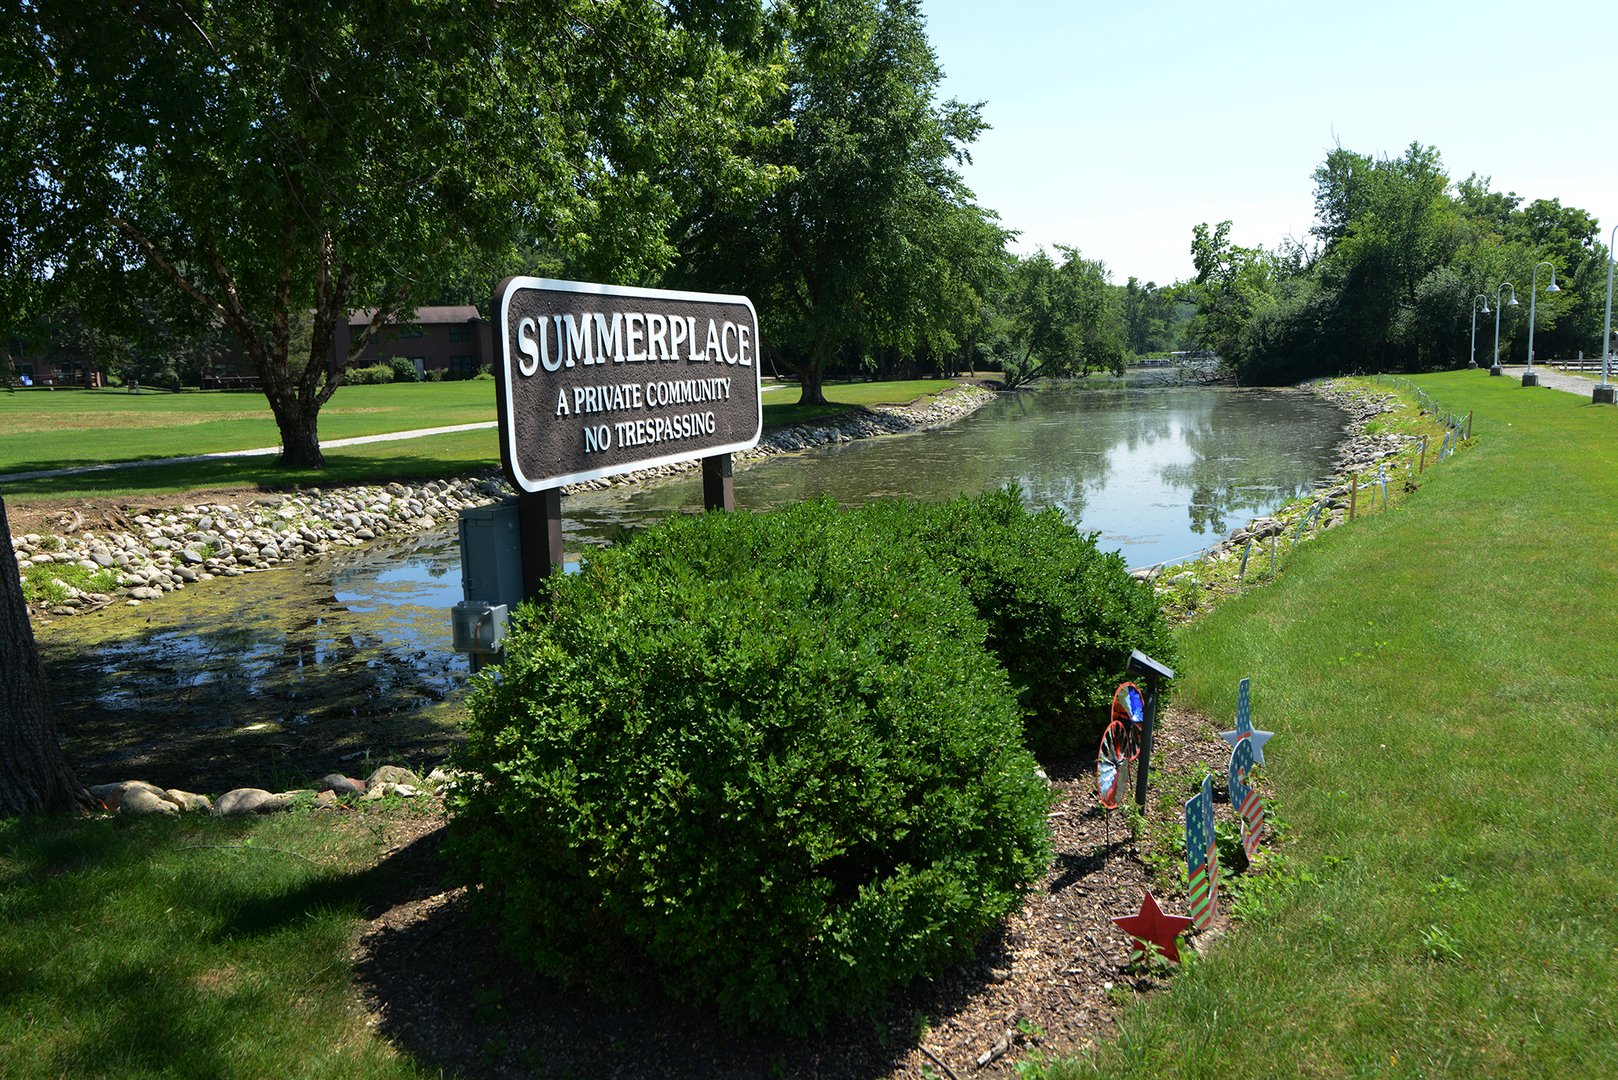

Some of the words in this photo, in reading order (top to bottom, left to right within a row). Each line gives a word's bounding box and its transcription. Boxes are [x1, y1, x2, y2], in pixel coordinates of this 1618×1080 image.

[518, 313, 752, 376] SUMMERPLACE
[556, 389, 570, 416] A
[573, 384, 641, 414] PRIVATE
[646, 377, 731, 407] COMMUNITY
[584, 426, 611, 453] NO
[614, 411, 715, 448] TRESPASSING
